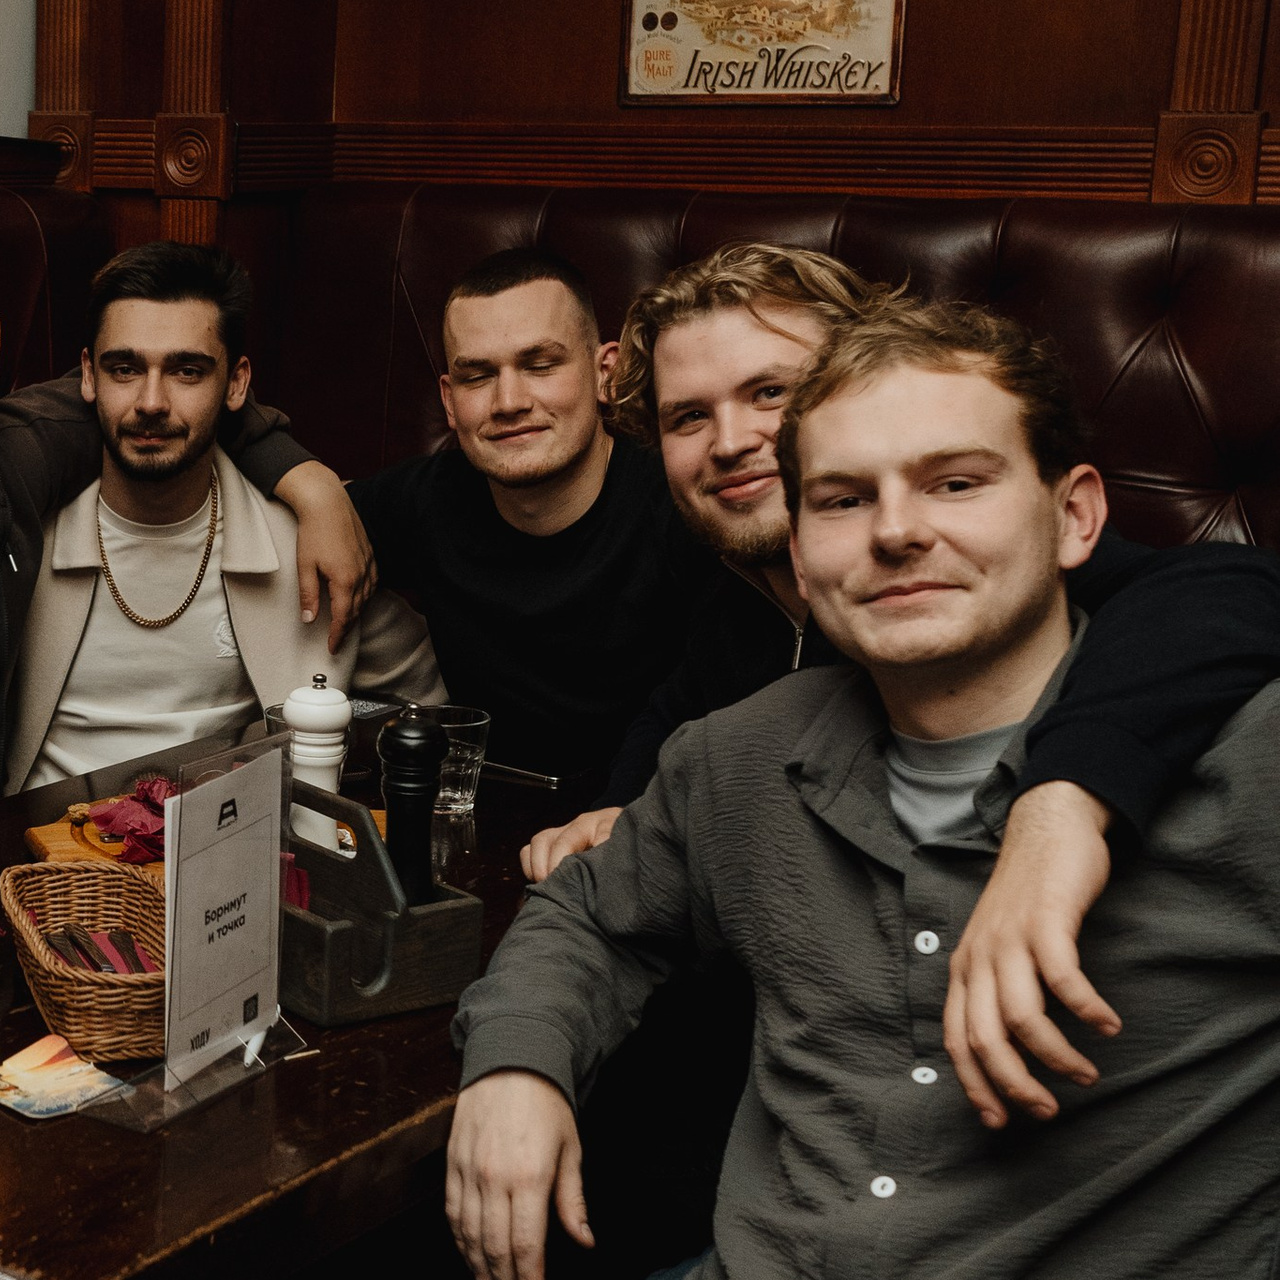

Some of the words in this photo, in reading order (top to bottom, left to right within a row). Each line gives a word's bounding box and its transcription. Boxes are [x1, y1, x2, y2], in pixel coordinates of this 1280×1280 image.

[644, 50, 671, 70] PURE
[204, 893, 247, 925] Борнмут
[207, 932, 215, 945] и
[217, 915, 246, 939] точка
